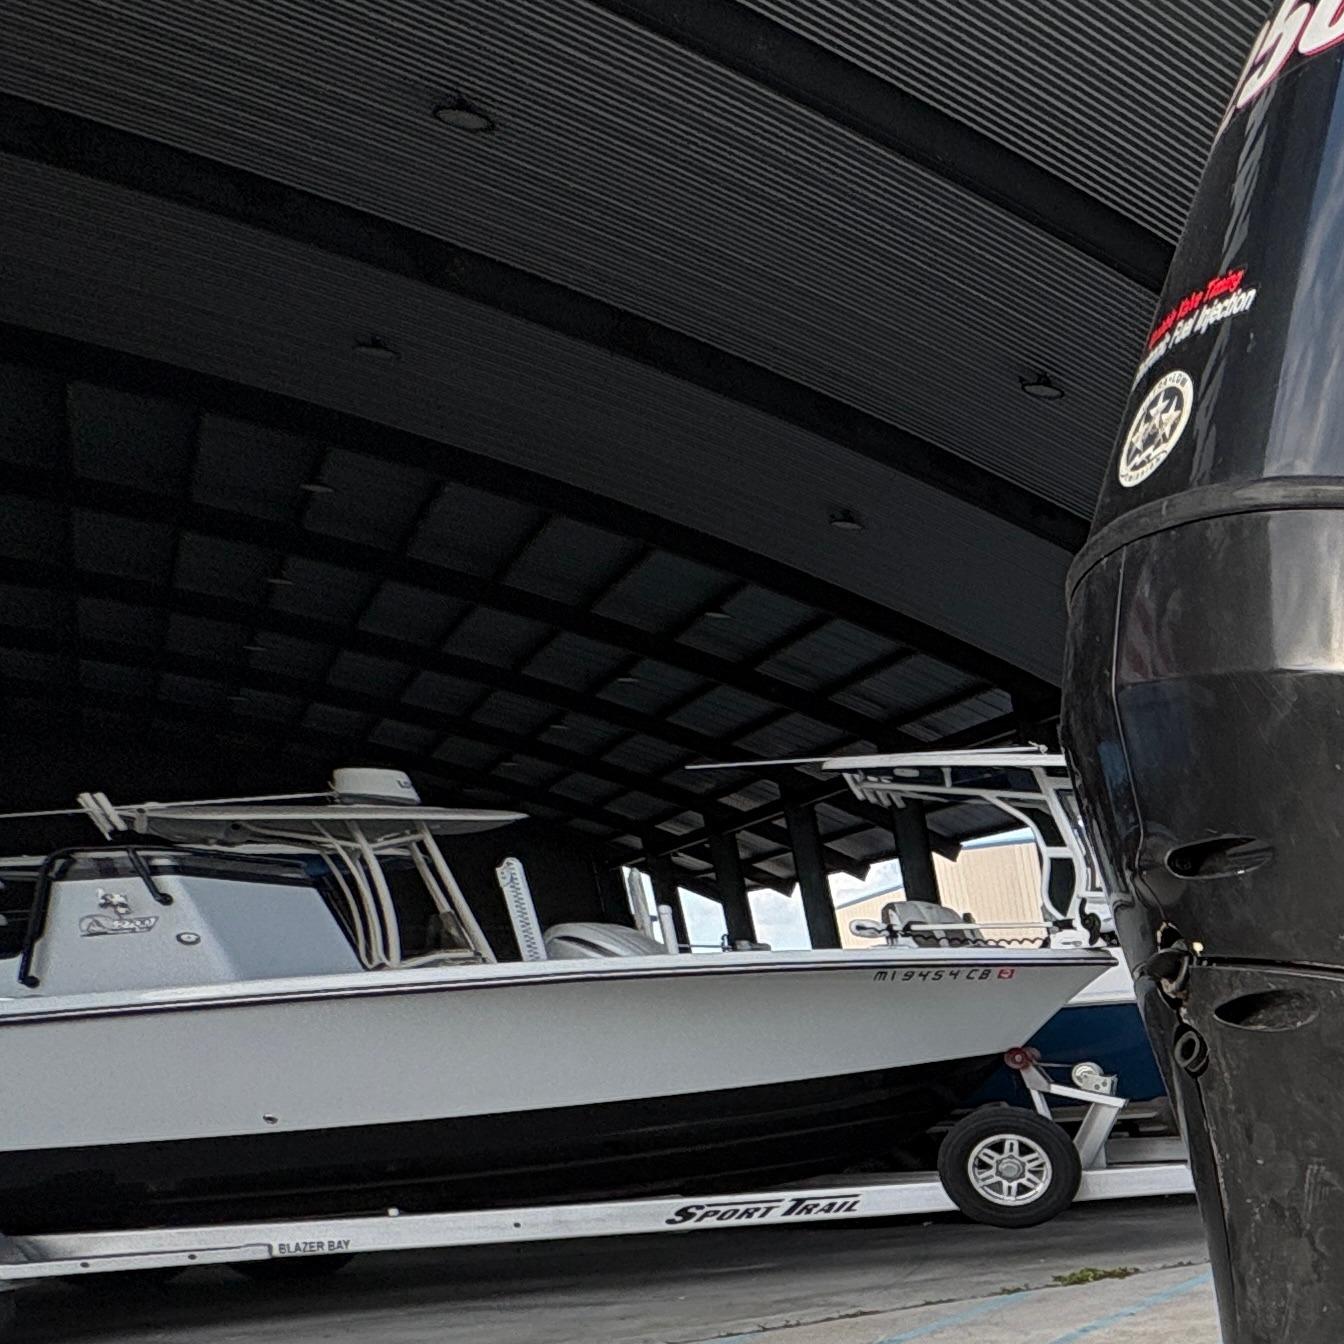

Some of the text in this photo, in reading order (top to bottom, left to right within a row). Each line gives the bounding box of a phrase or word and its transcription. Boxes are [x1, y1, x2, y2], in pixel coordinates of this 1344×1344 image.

[1193, 287, 1256, 334] Injection
[665, 1193, 864, 1225] SPORT TRAIL
[278, 1239, 351, 1254] BLAZER BAY
